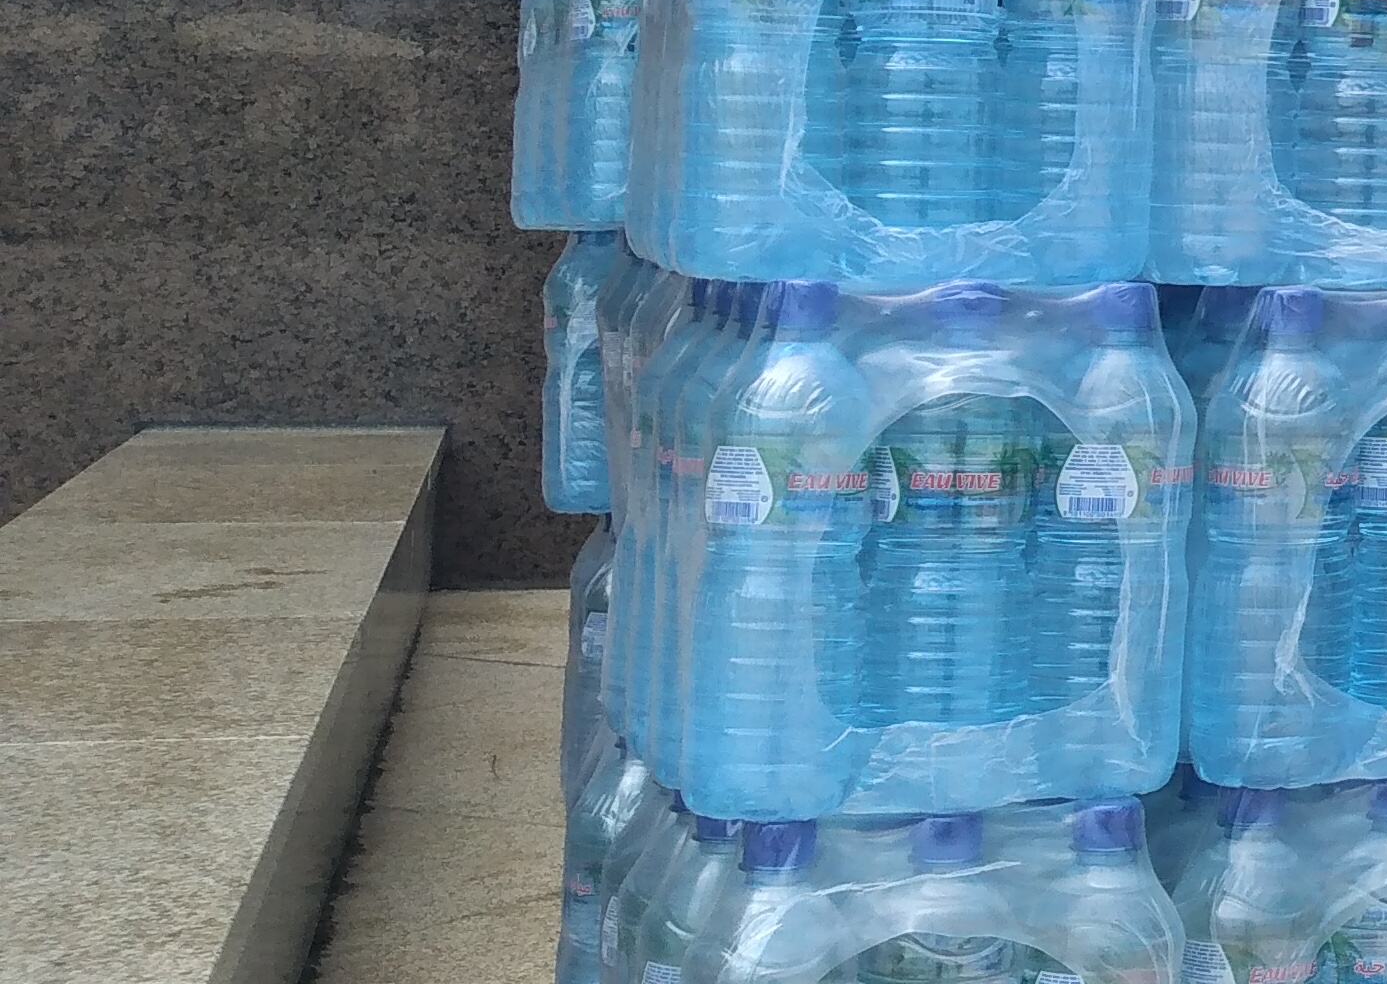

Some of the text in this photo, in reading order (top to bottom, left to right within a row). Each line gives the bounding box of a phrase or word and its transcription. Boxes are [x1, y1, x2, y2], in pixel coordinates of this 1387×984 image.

[788, 472, 869, 491] EAU VIVE
[911, 472, 1001, 490] EAU VIVE
[1232, 472, 1273, 486] VIVE
[1355, 958, 1384, 974] حية
[1250, 967, 1286, 983] EAU
